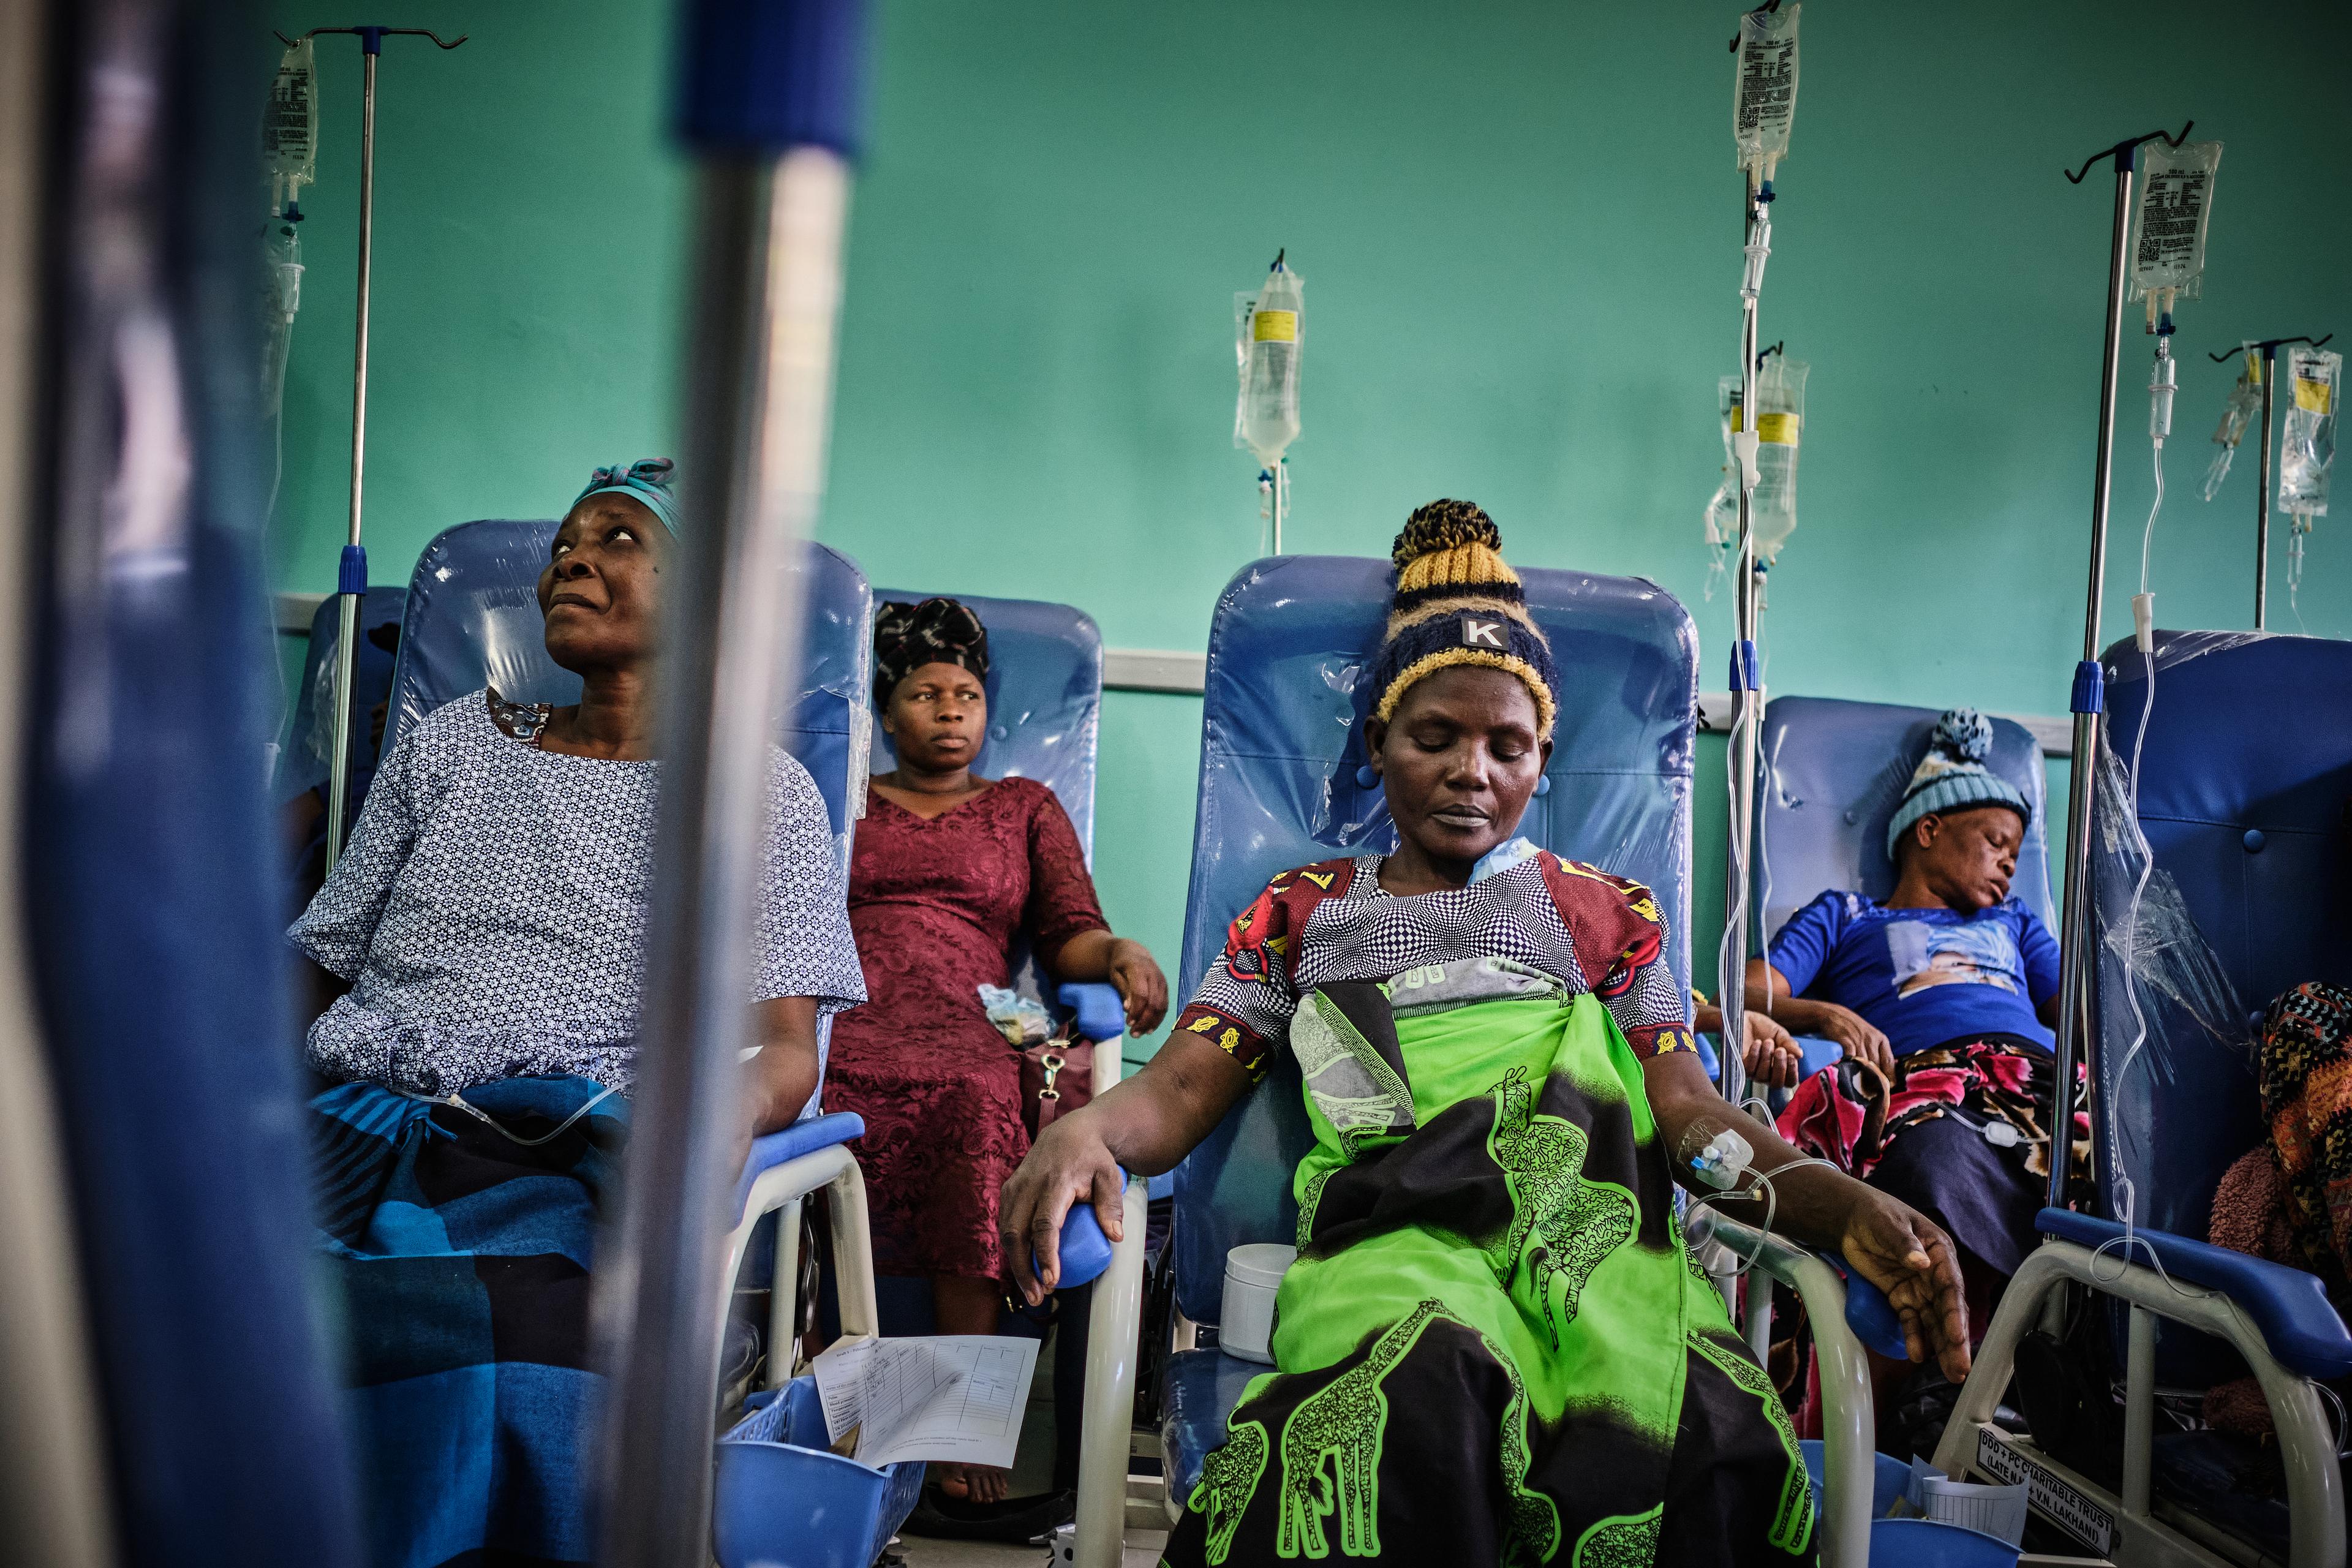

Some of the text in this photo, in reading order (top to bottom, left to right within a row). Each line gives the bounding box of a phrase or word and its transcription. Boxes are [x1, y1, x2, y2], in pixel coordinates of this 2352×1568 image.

[1468, 620, 1502, 647] K
[1982, 1434, 2111, 1531] DDD + PC CHARITABLE TRUST
[1987, 1456, 2009, 1478] (LATE
[2010, 1471, 2025, 1485] N.N
[2037, 1489, 2052, 1510] V.N.
[2054, 1501, 2099, 1545] LAKHANI)
